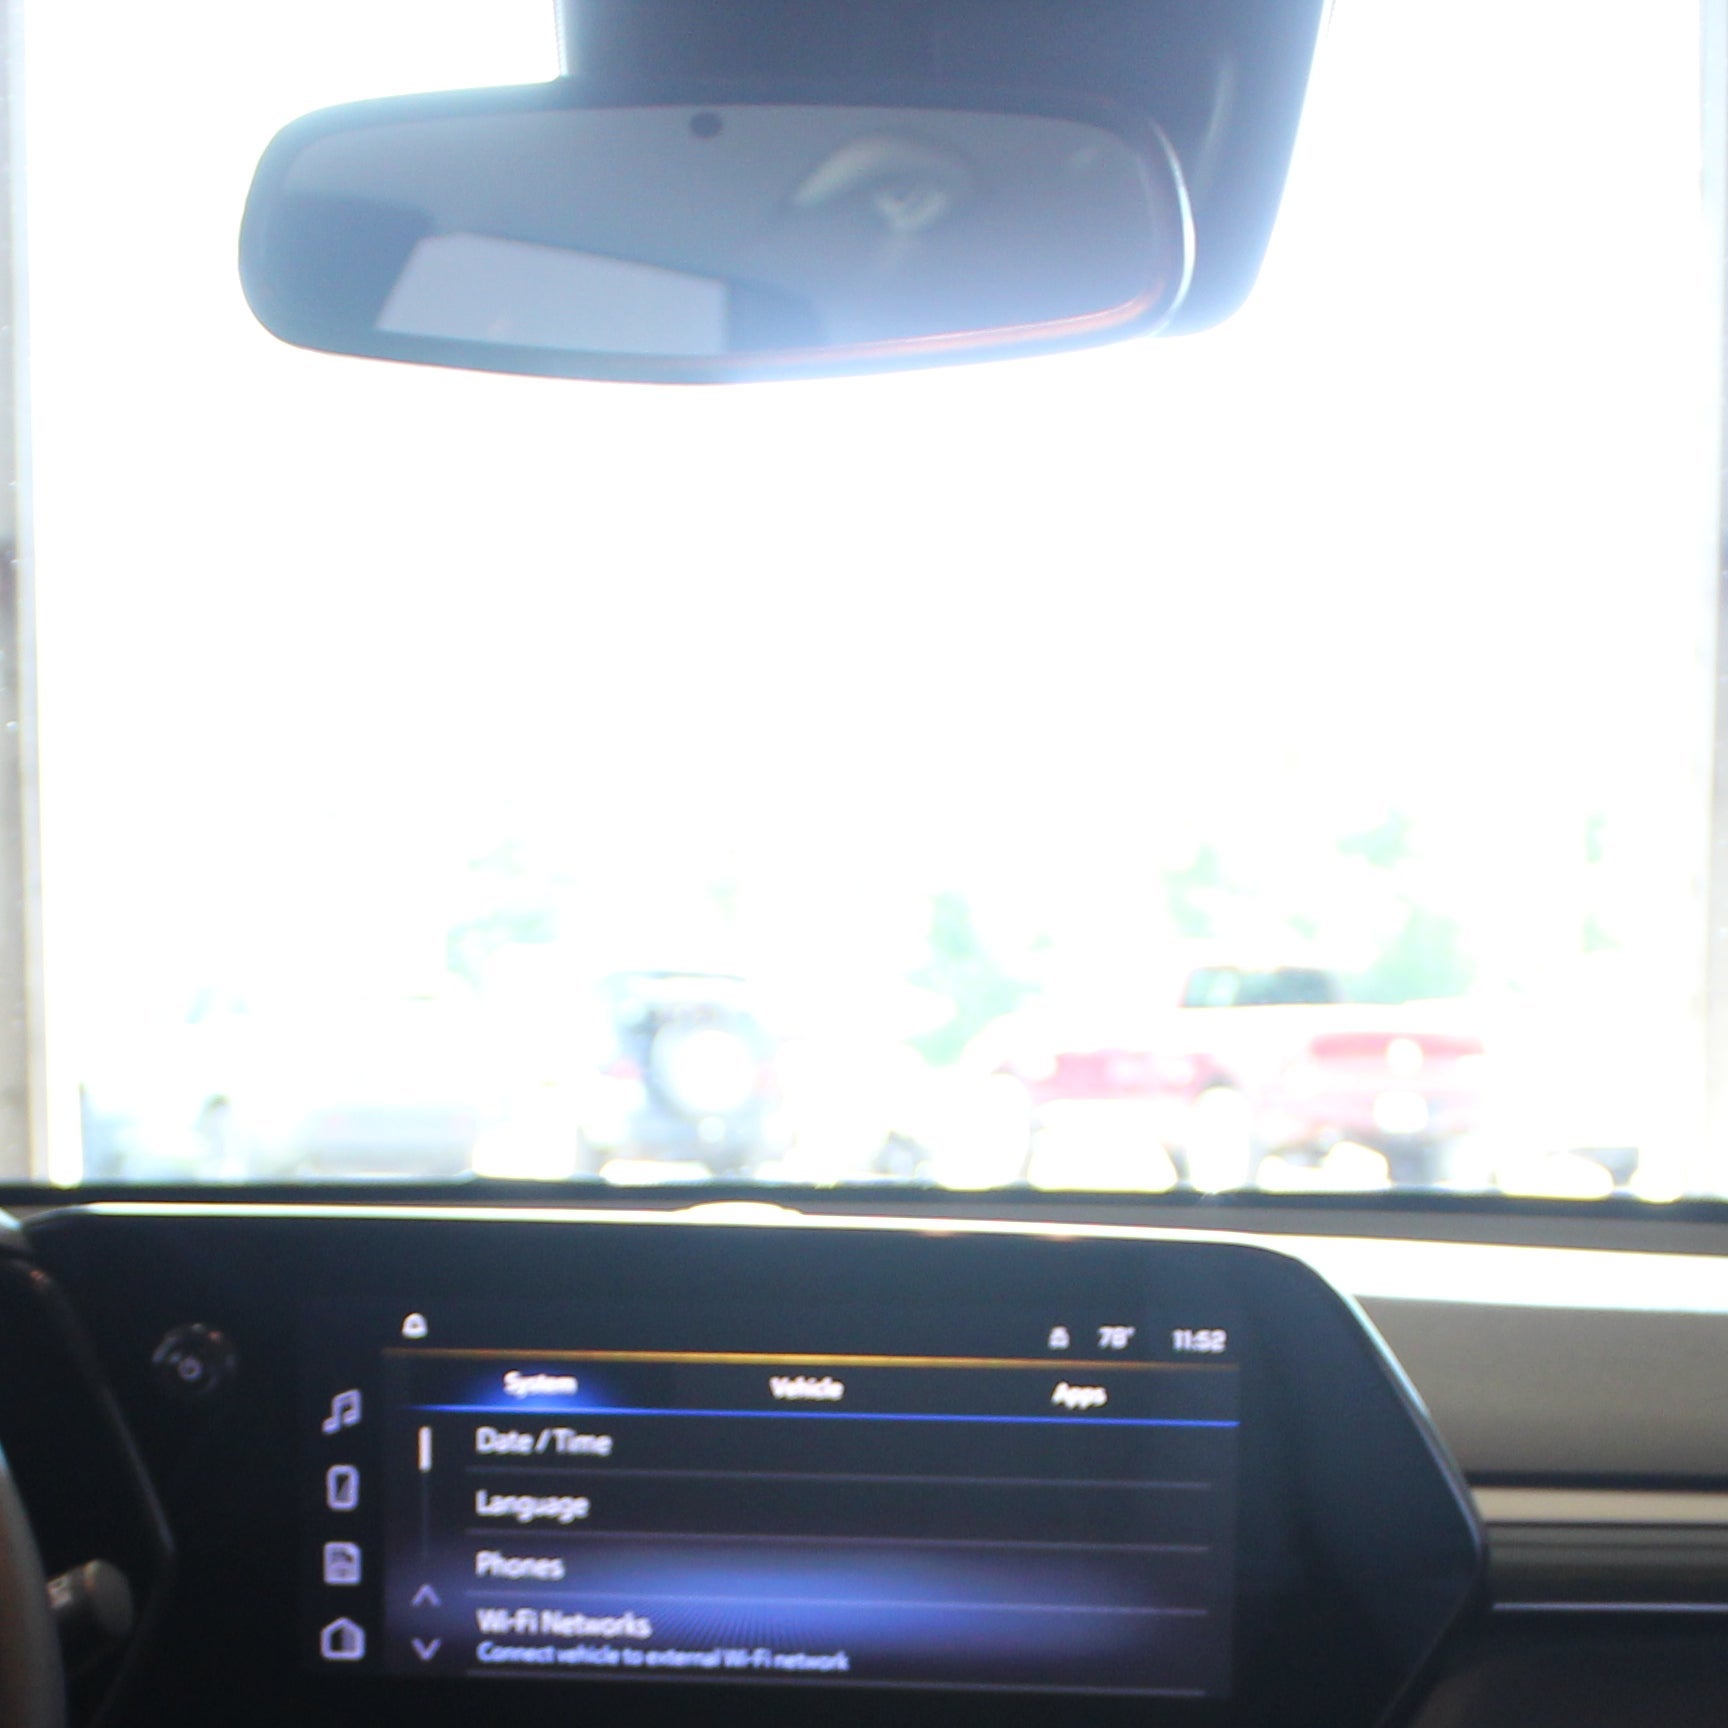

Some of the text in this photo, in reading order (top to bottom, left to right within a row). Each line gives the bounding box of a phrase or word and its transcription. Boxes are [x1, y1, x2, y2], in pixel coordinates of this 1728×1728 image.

[1172, 1329, 1227, 1352] 11:52
[503, 1370, 579, 1399] System
[769, 1375, 845, 1401] Vehicle
[1051, 1382, 1108, 1410] Apps
[476, 1426, 534, 1455] Date
[553, 1427, 614, 1457] Time
[475, 1489, 591, 1523] Language
[475, 1550, 566, 1581] Phones
[476, 1608, 653, 1640] Wi-Fi Networks
[476, 1640, 850, 1671] Connect vehicle to external Wi-Fi network
